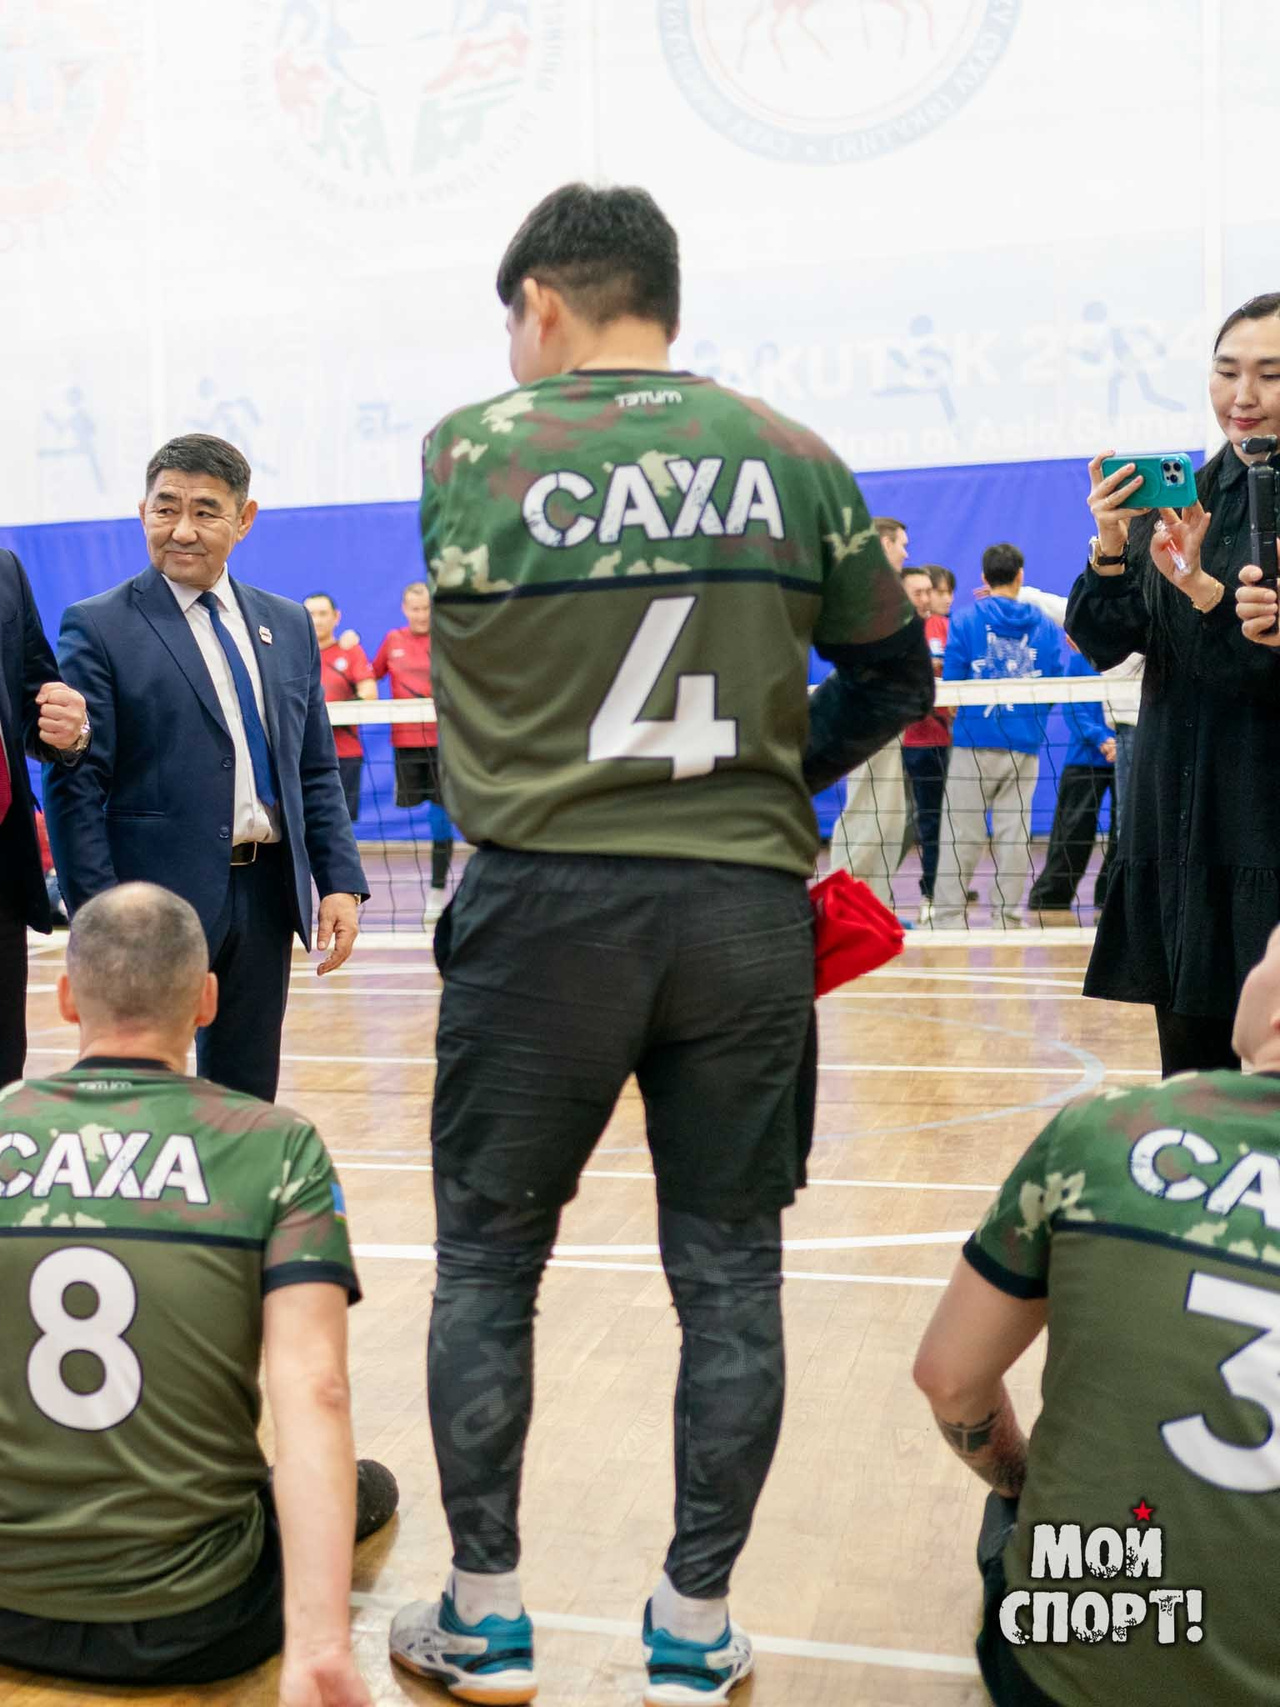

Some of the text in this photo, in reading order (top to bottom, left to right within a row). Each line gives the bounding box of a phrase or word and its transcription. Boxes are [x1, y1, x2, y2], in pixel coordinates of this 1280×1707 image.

[523, 457, 785, 547] САХА
[588, 596, 737, 780] 4
[1129, 1128, 1280, 1230] СА
[27, 1247, 142, 1431] 8
[1159, 1270, 1280, 1492] 3
